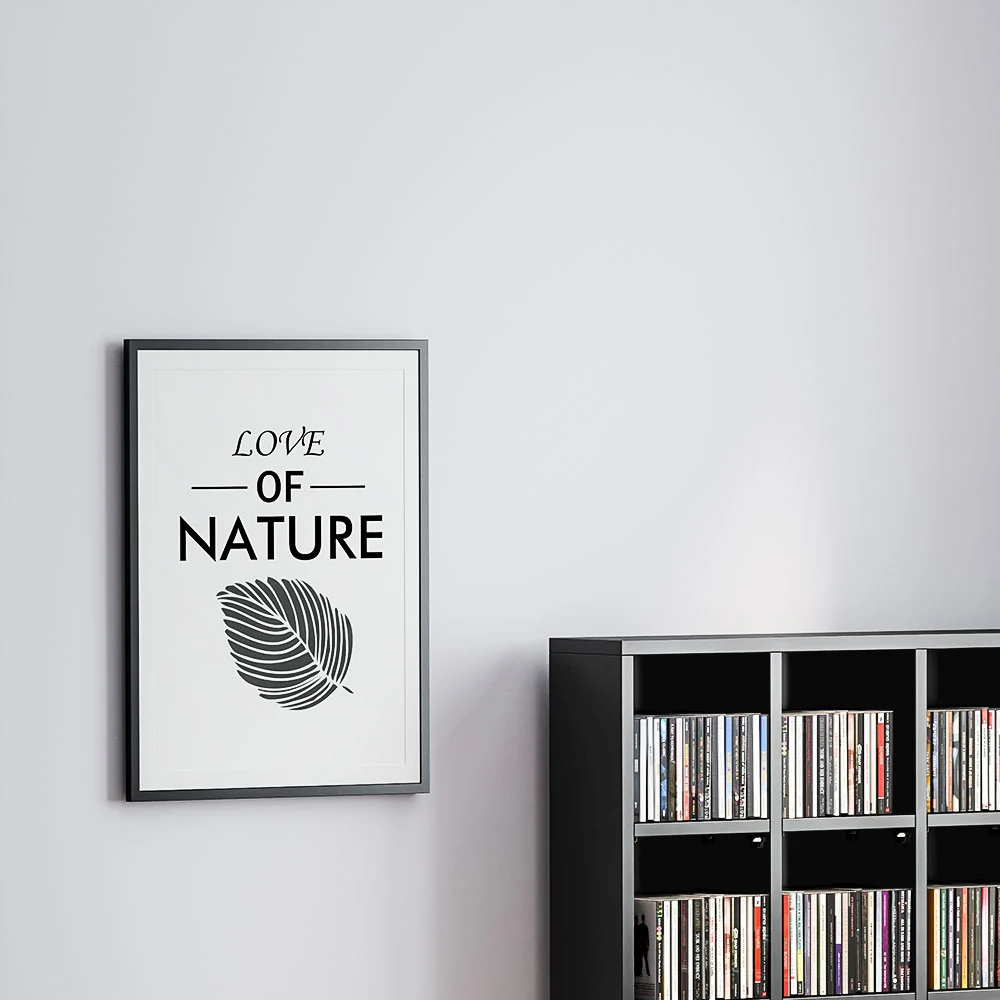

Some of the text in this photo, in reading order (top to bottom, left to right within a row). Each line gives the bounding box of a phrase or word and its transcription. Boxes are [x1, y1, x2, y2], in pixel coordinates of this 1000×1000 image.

[231, 425, 325, 457] LOVE
[256, 470, 304, 504] OF
[179, 514, 383, 562] NATURE
